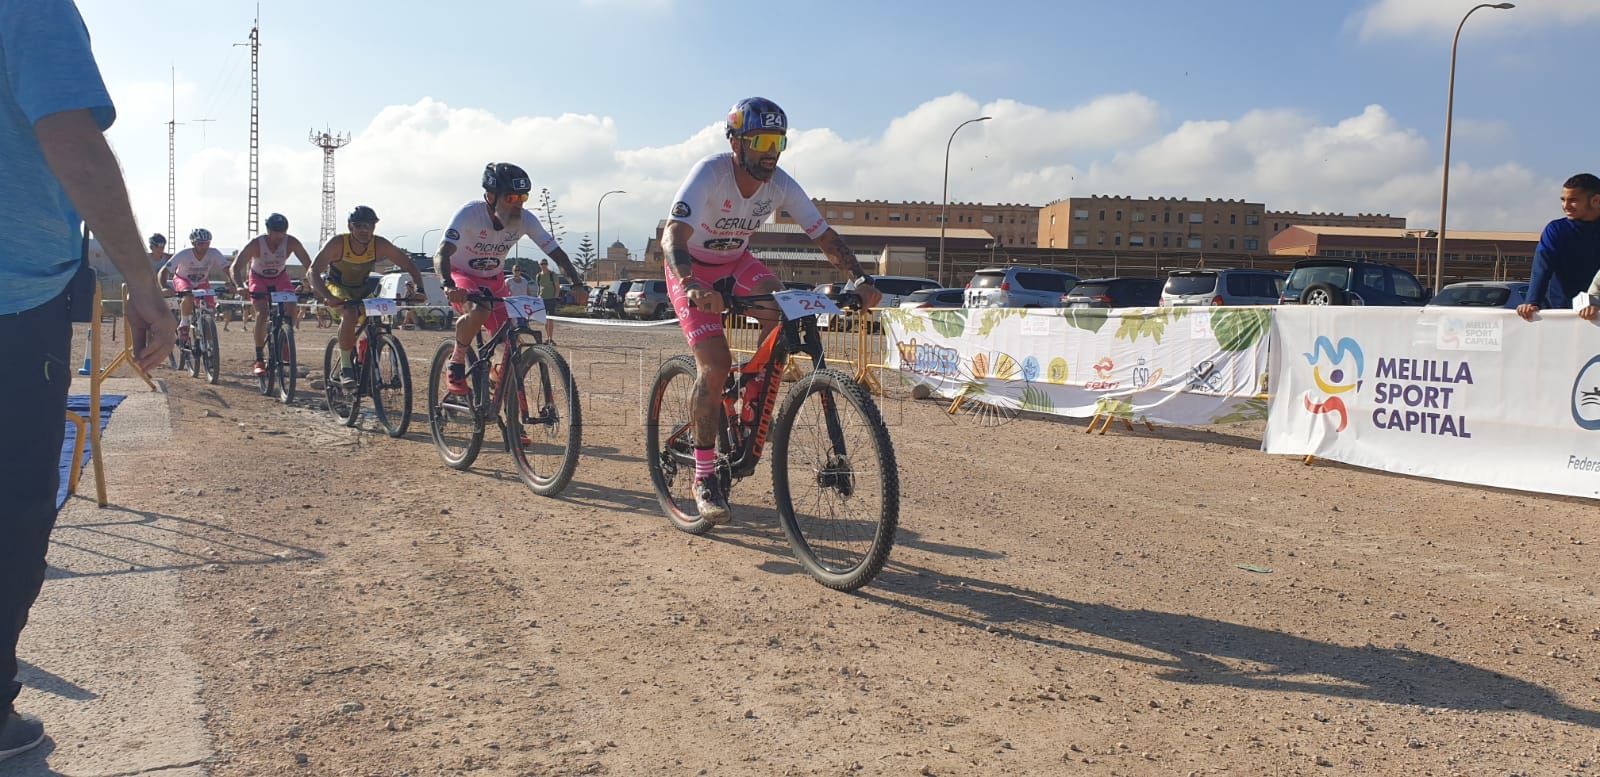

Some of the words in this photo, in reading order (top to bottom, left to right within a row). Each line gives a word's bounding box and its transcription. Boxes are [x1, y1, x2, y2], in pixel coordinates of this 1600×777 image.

[765, 113, 783, 126] 24
[715, 217, 761, 231] CERILLA
[375, 303, 389, 312] 18
[523, 303, 533, 316] 5
[798, 299, 827, 311] 24
[1464, 329, 1493, 337] SPORT
[1464, 337, 1499, 346] CAPITAL
[1375, 356, 1474, 385] MELILLA
[1374, 381, 1454, 410] SPORT
[1371, 407, 1472, 440] CAPITAL
